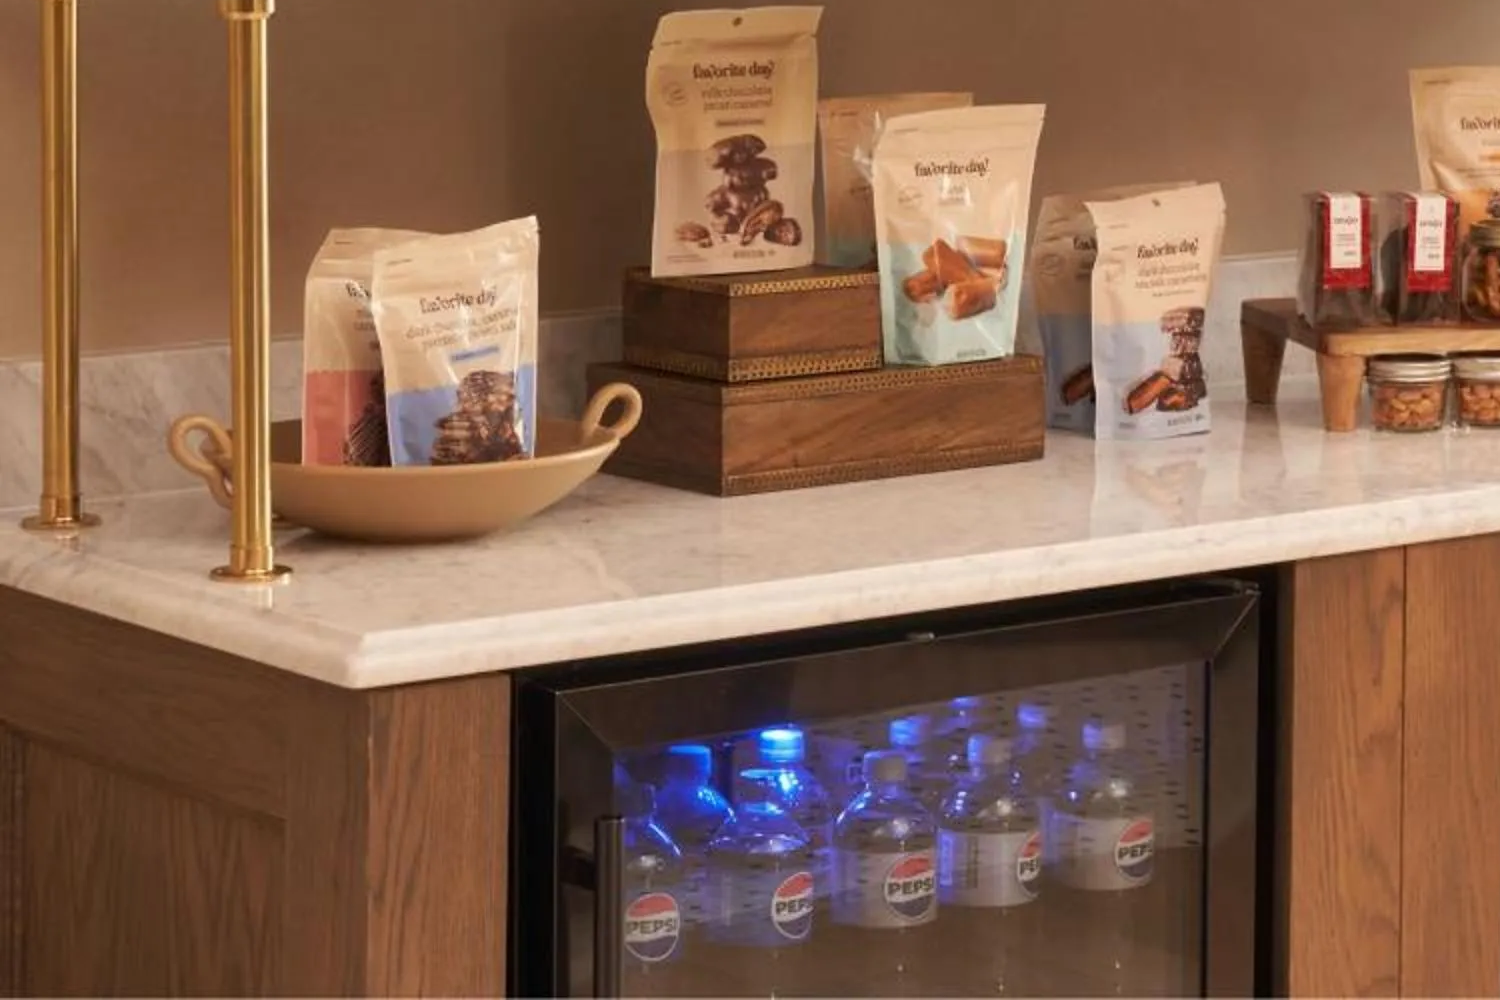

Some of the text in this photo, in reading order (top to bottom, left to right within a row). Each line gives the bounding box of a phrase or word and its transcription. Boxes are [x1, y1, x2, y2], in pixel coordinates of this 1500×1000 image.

[692, 60, 775, 80] favorite day
[914, 158, 989, 177] favorite day
[1137, 243, 1177, 259] favorite
[419, 292, 473, 314] favorite
